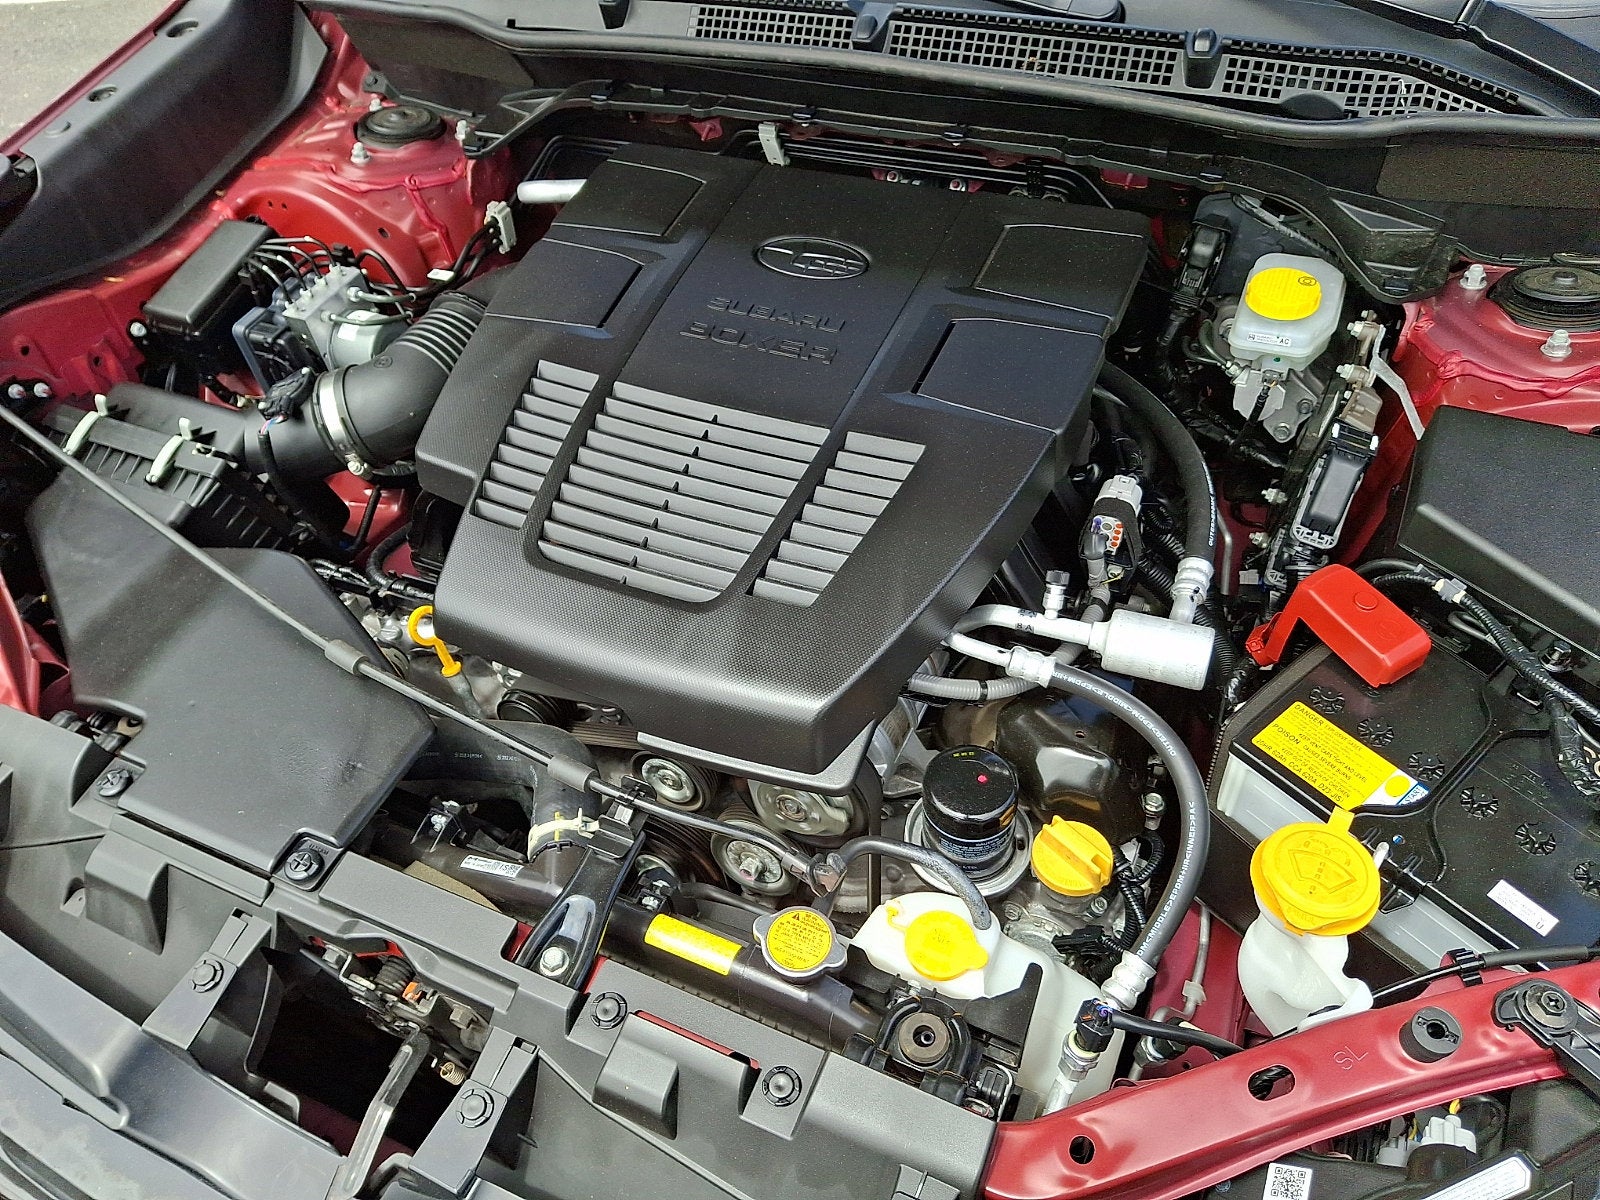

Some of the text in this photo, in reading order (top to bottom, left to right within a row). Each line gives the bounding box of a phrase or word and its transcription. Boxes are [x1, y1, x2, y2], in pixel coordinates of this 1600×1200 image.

[706, 297, 846, 334] SUBARU
[679, 321, 838, 365] BOXER
[1294, 704, 1324, 726] DANGER
[1272, 723, 1301, 745] POISON
[1288, 761, 1303, 773] CCA
[1333, 1045, 1369, 1071] SL
